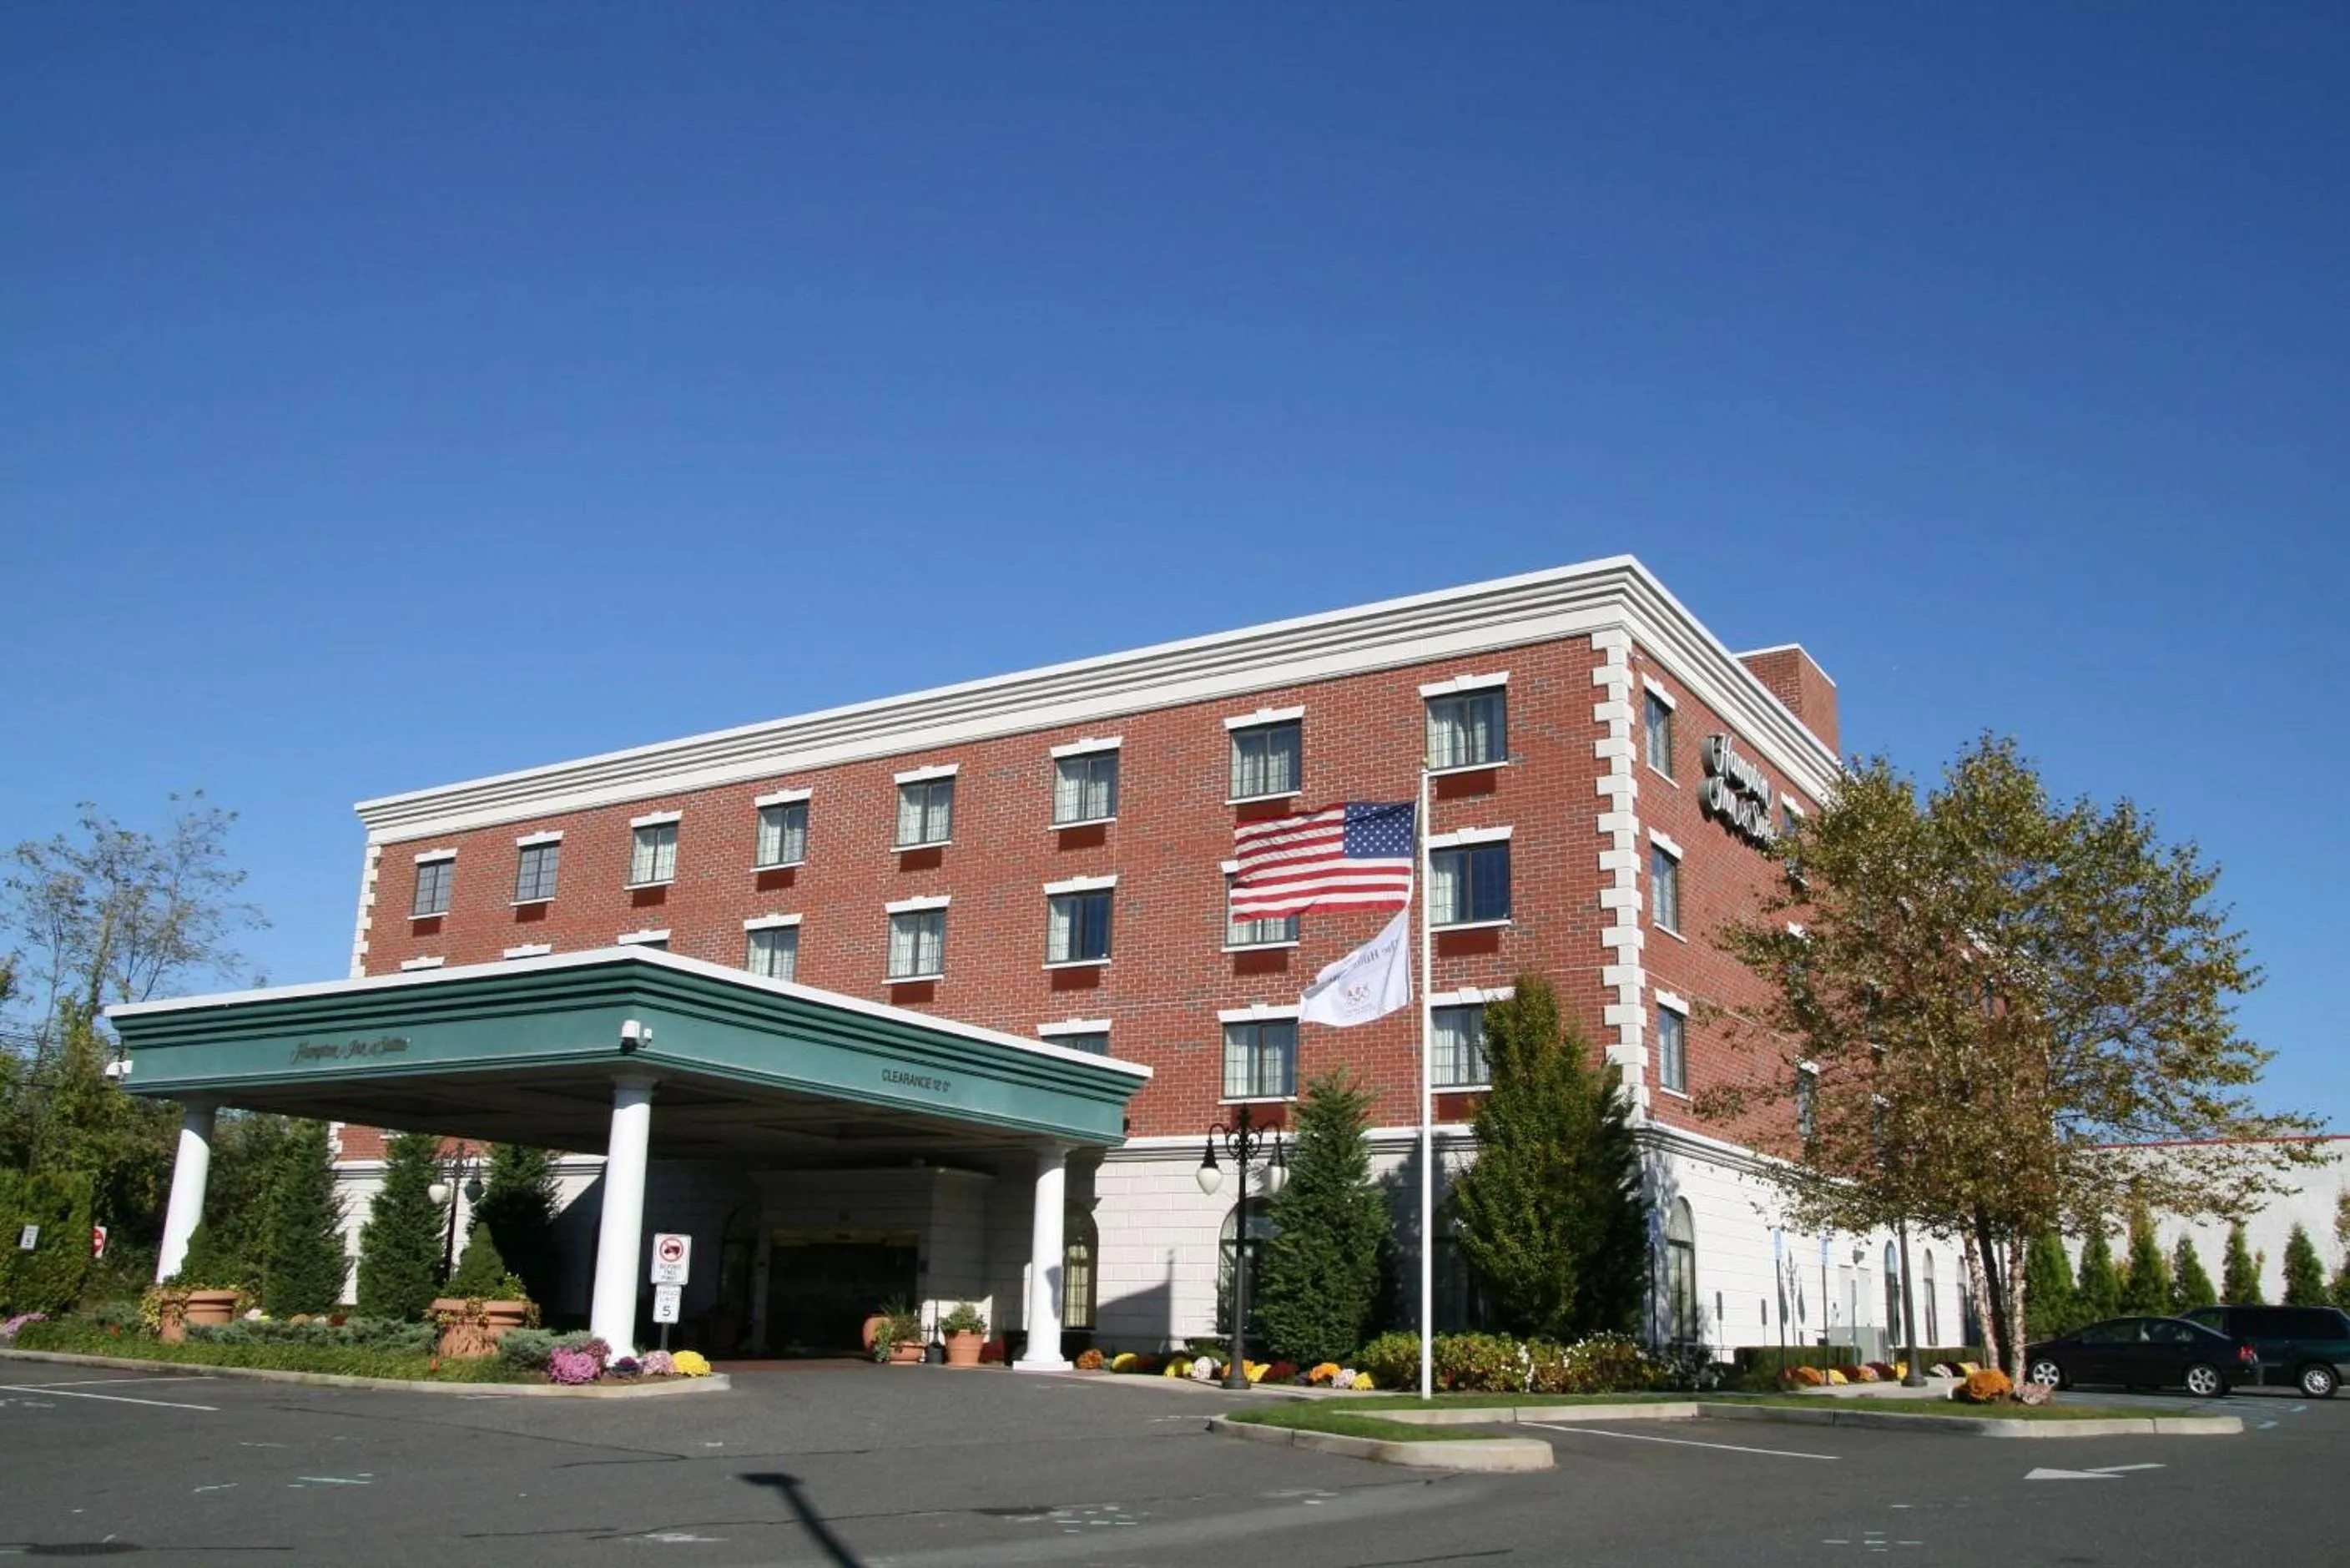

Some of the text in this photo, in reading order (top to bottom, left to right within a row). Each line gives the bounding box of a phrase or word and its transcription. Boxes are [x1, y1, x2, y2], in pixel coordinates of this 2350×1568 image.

[1706, 733, 1774, 809] Hampton
[1706, 776, 1742, 826] Inn
[881, 1068, 931, 1089] CLEARANCE
[663, 1305, 671, 1317] 5
